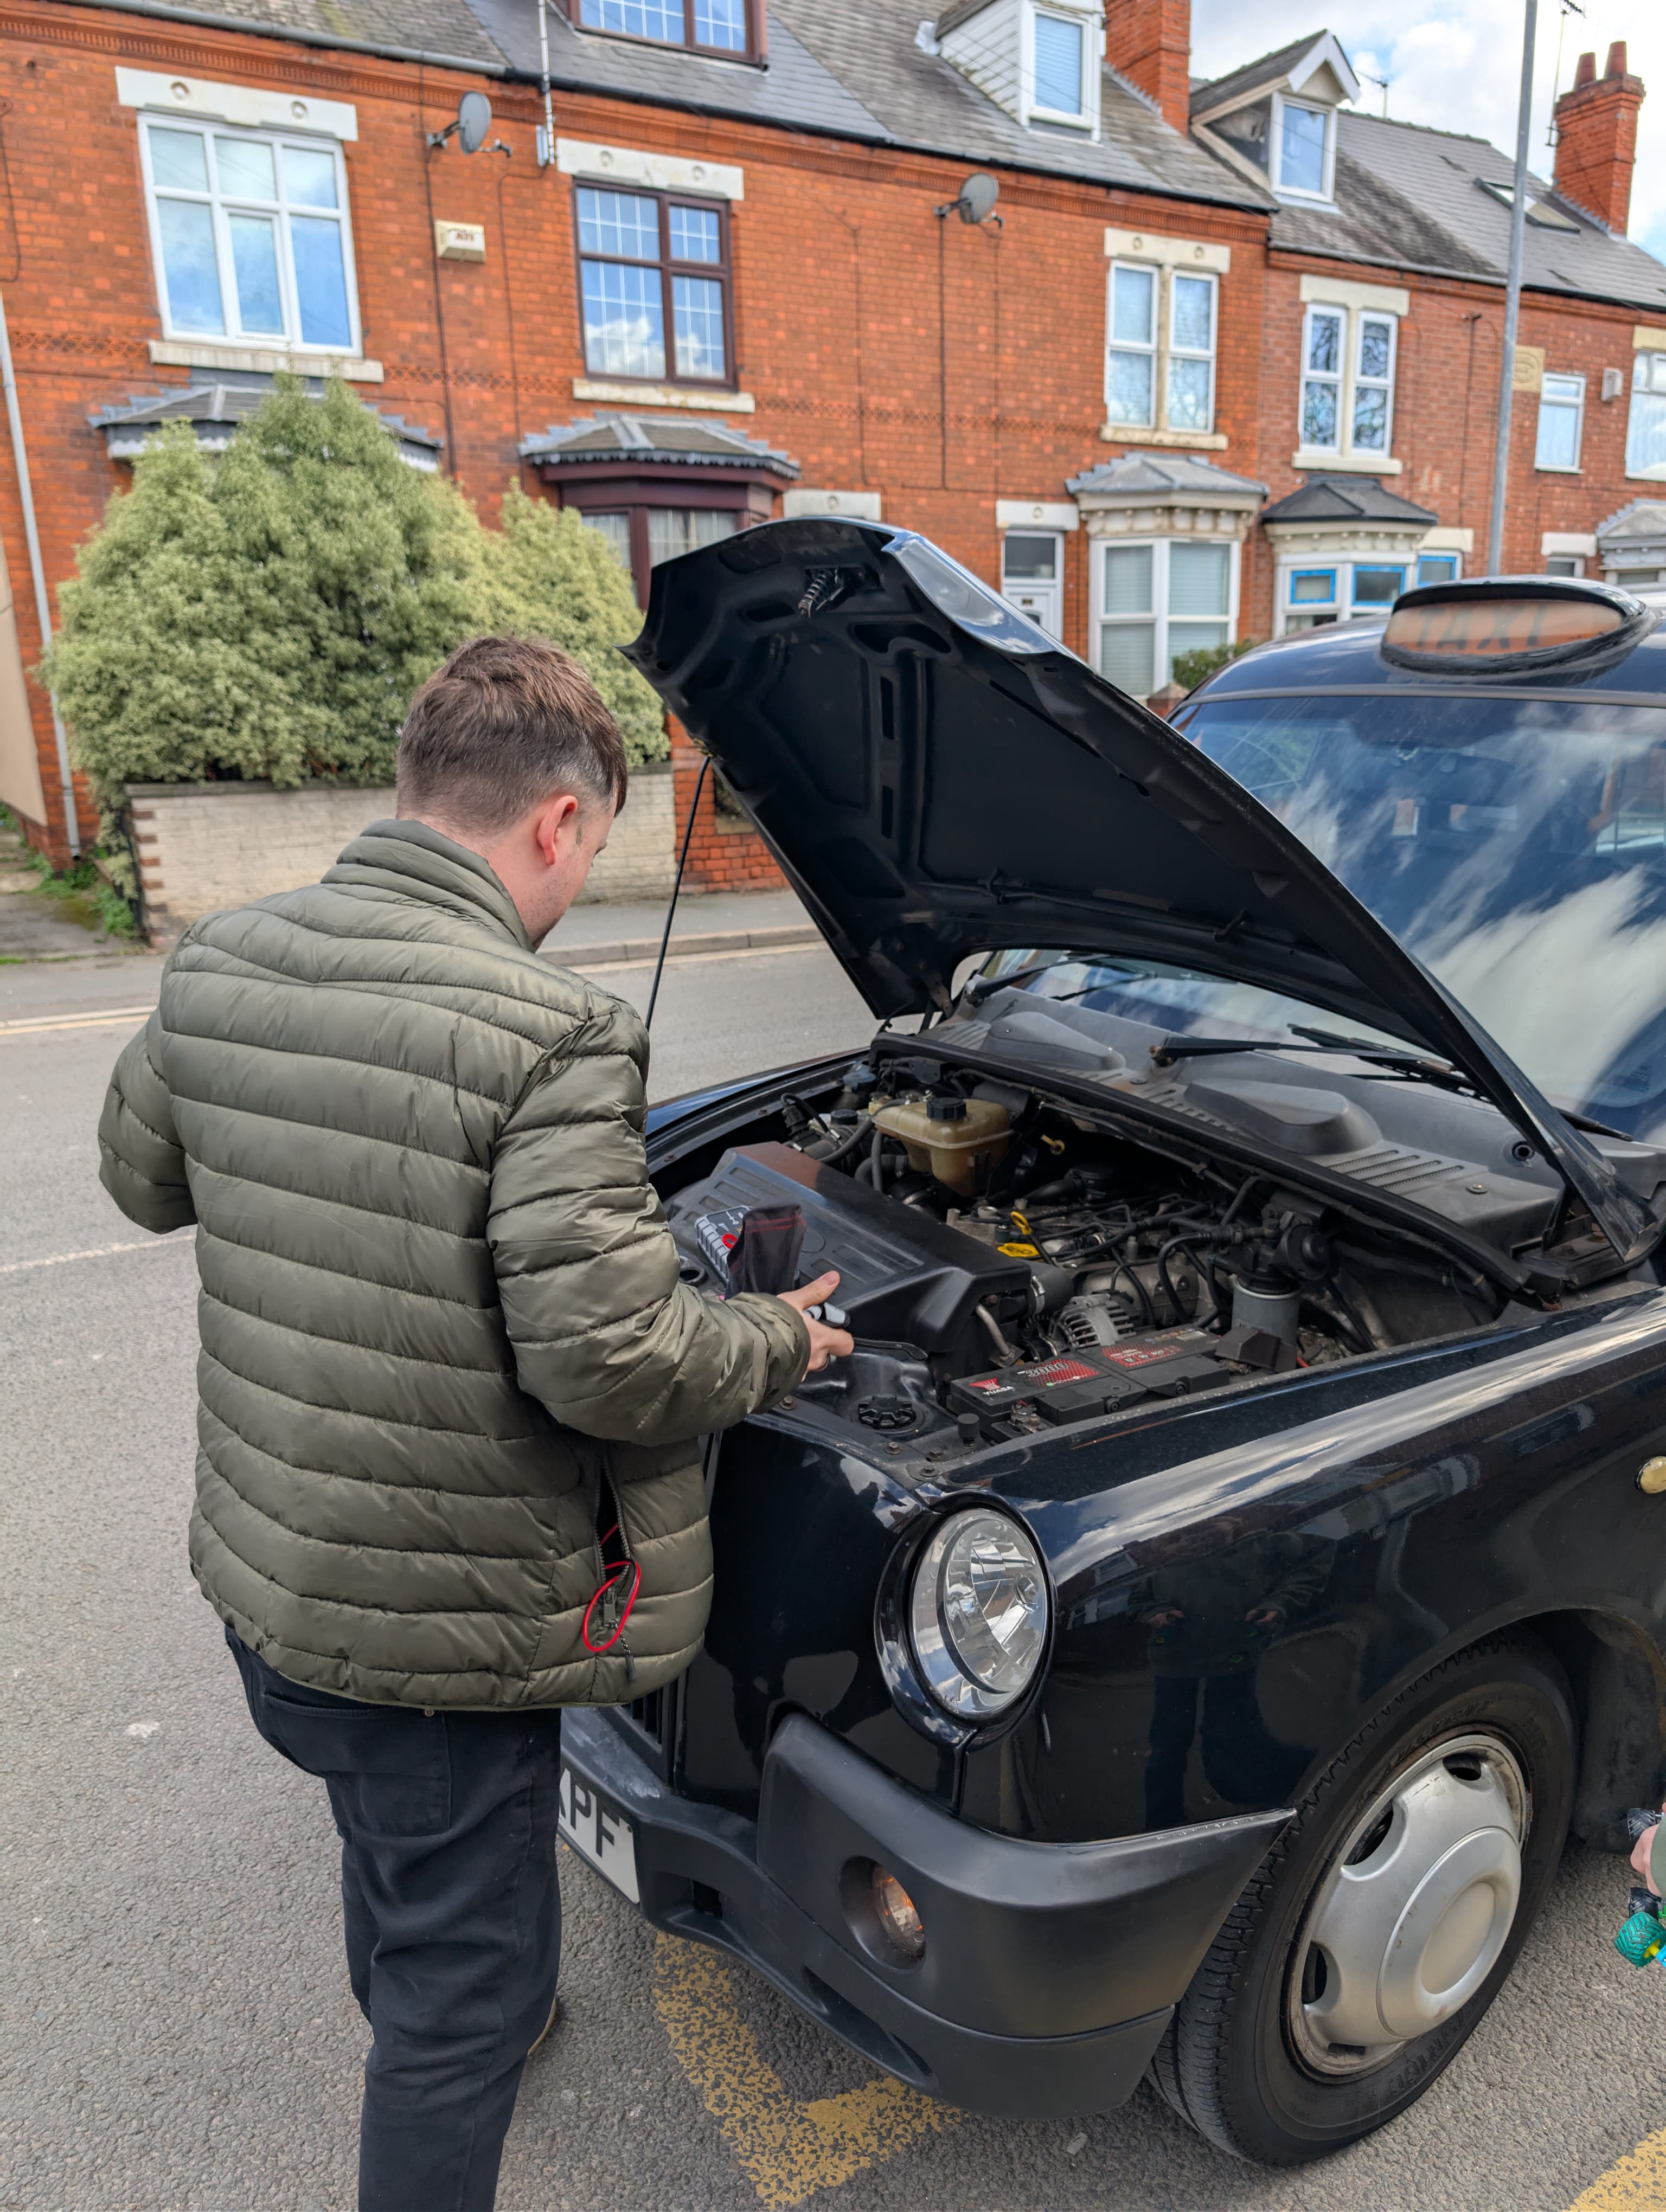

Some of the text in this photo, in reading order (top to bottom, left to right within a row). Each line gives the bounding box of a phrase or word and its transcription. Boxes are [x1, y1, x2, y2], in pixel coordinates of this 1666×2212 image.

[1418, 603, 1548, 650] TAXI
[1026, 1361, 1069, 1377] 3000
[983, 1385, 1015, 1396] YUASA
